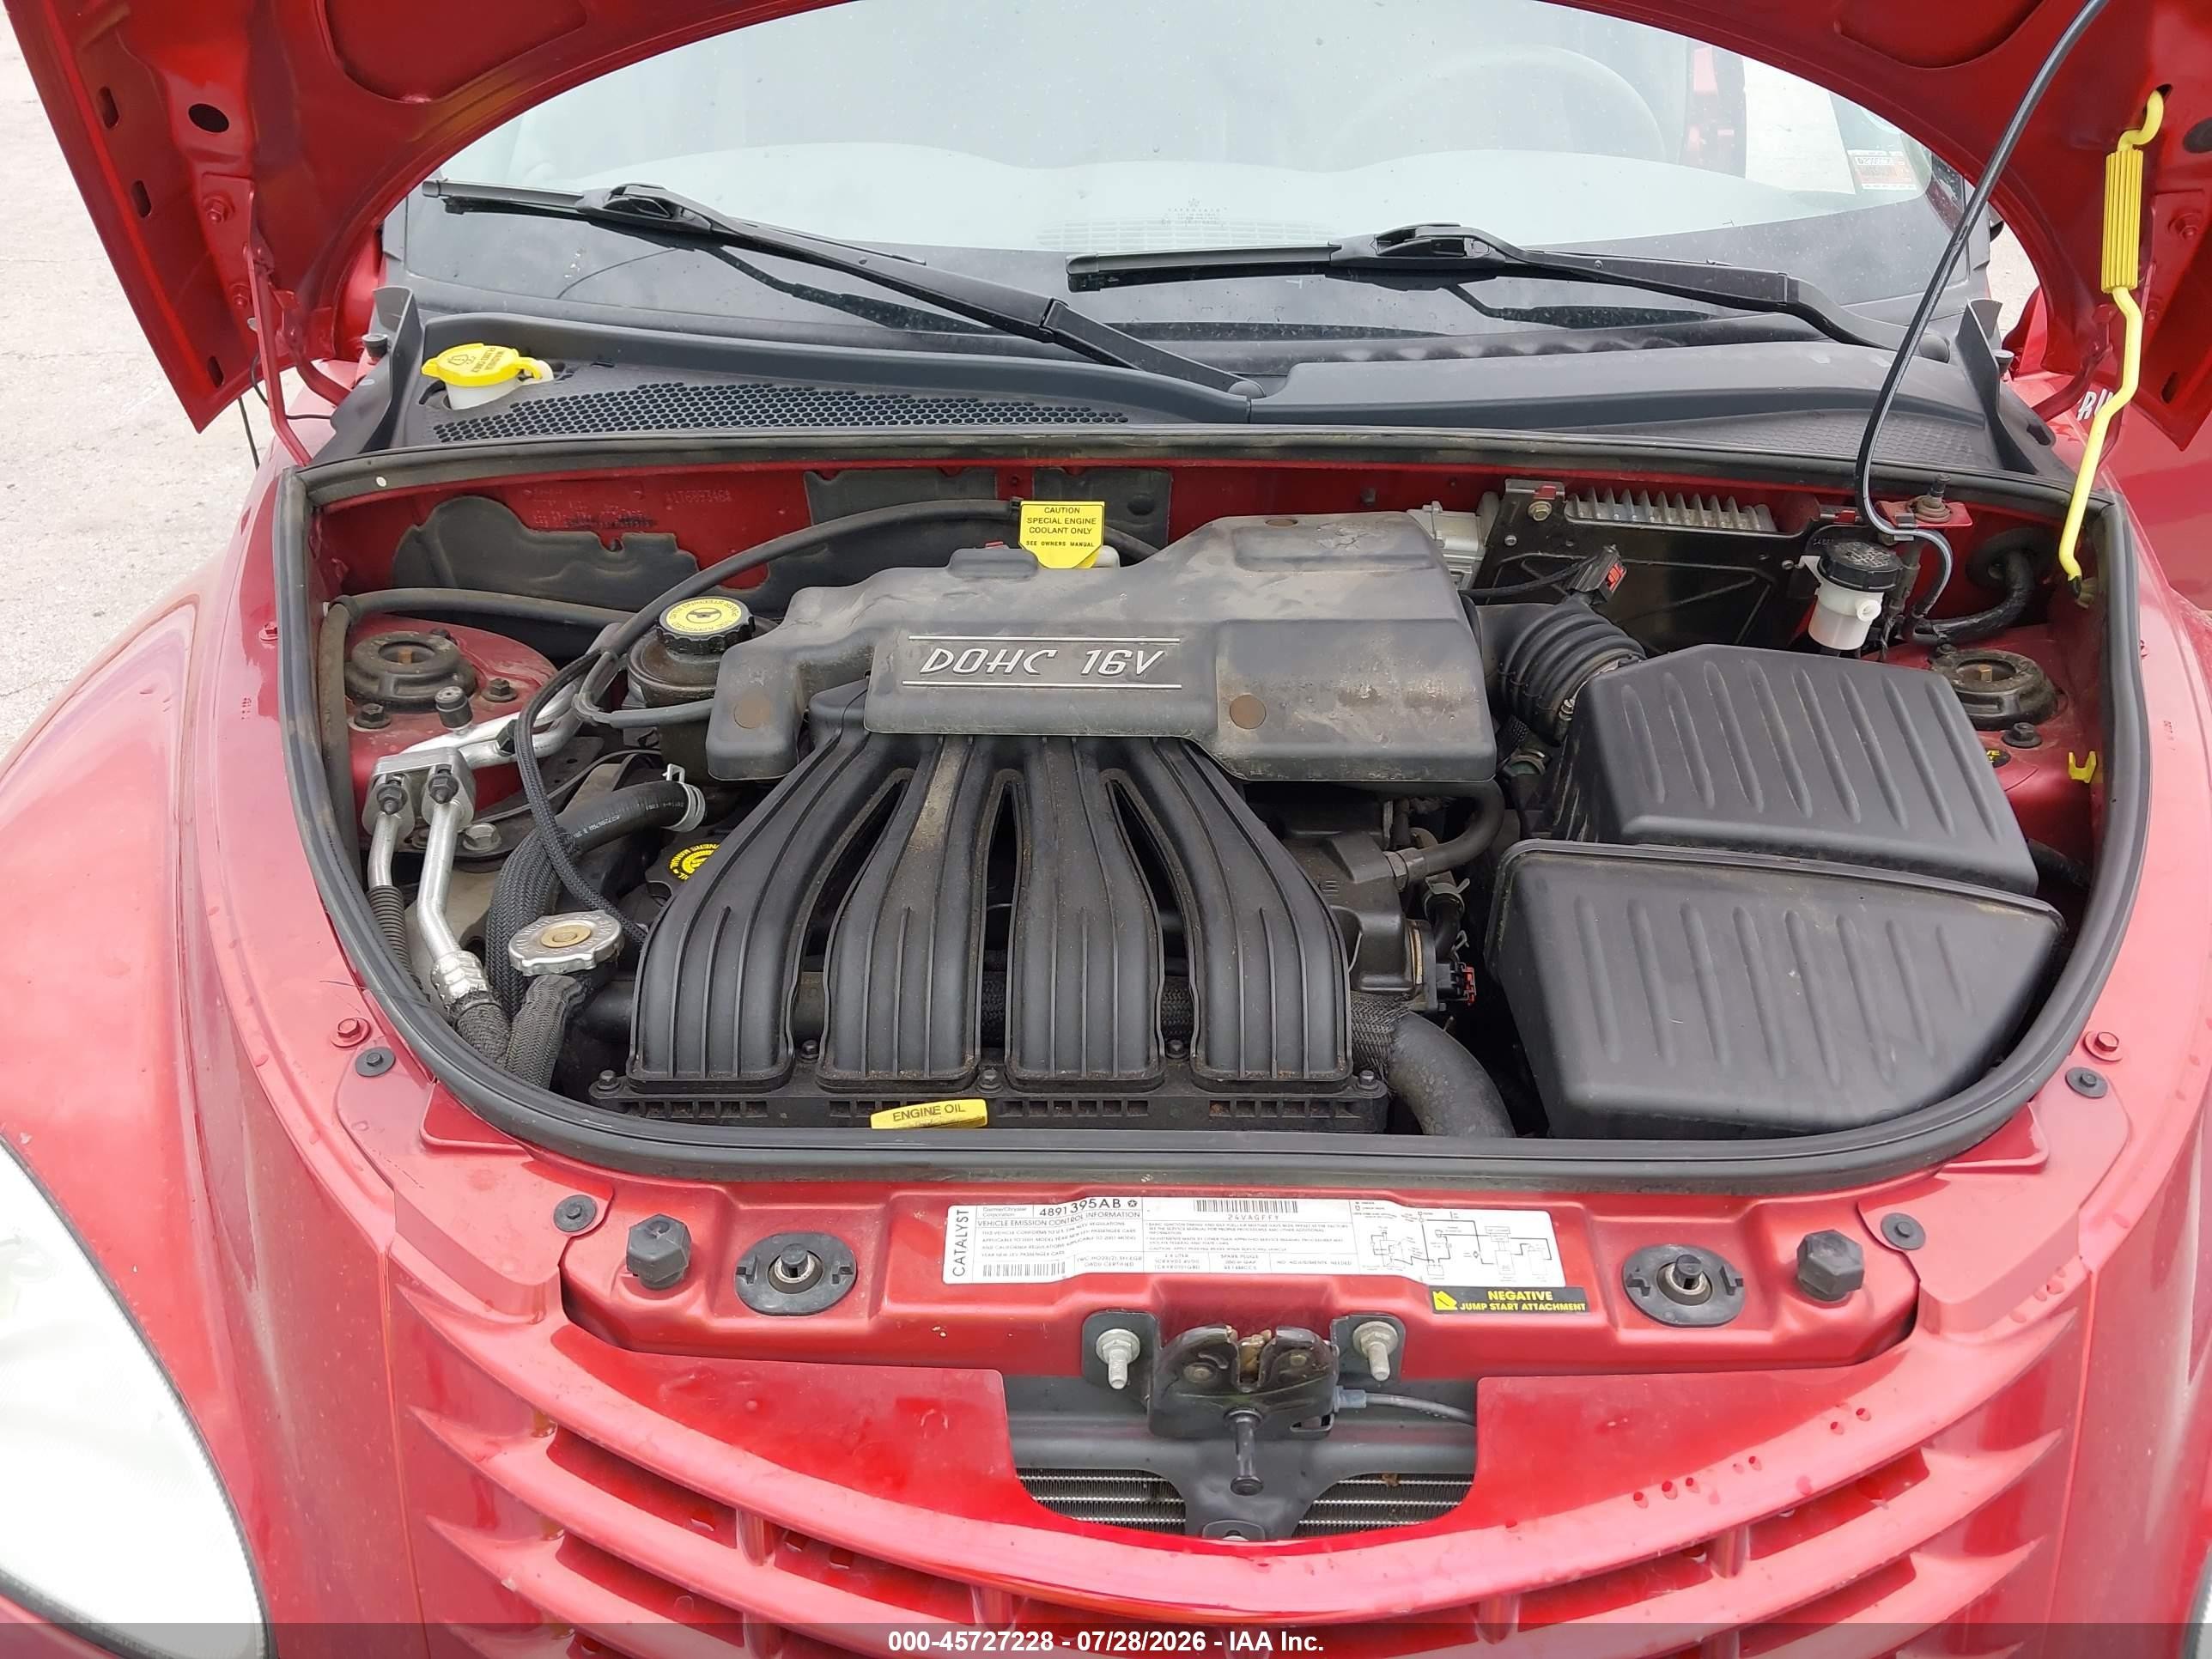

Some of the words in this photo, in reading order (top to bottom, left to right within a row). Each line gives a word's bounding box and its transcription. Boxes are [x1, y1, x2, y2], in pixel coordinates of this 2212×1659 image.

[921, 648, 1057, 675] DOHC
[1081, 649, 1164, 676] 16V
[892, 1105, 942, 1121] ENGINE
[945, 1103, 967, 1114] OIL
[1039, 1198, 1121, 1216] 4891395AB
[1048, 1214, 1084, 1226] CONTROL
[952, 1209, 969, 1277] CATALYST
[1487, 1291, 1553, 1302] NEGATIVE
[1460, 1303, 1488, 1312] JUMP
[1489, 1303, 1520, 1311] START
[1521, 1303, 1587, 1312] ATTACHMENT
